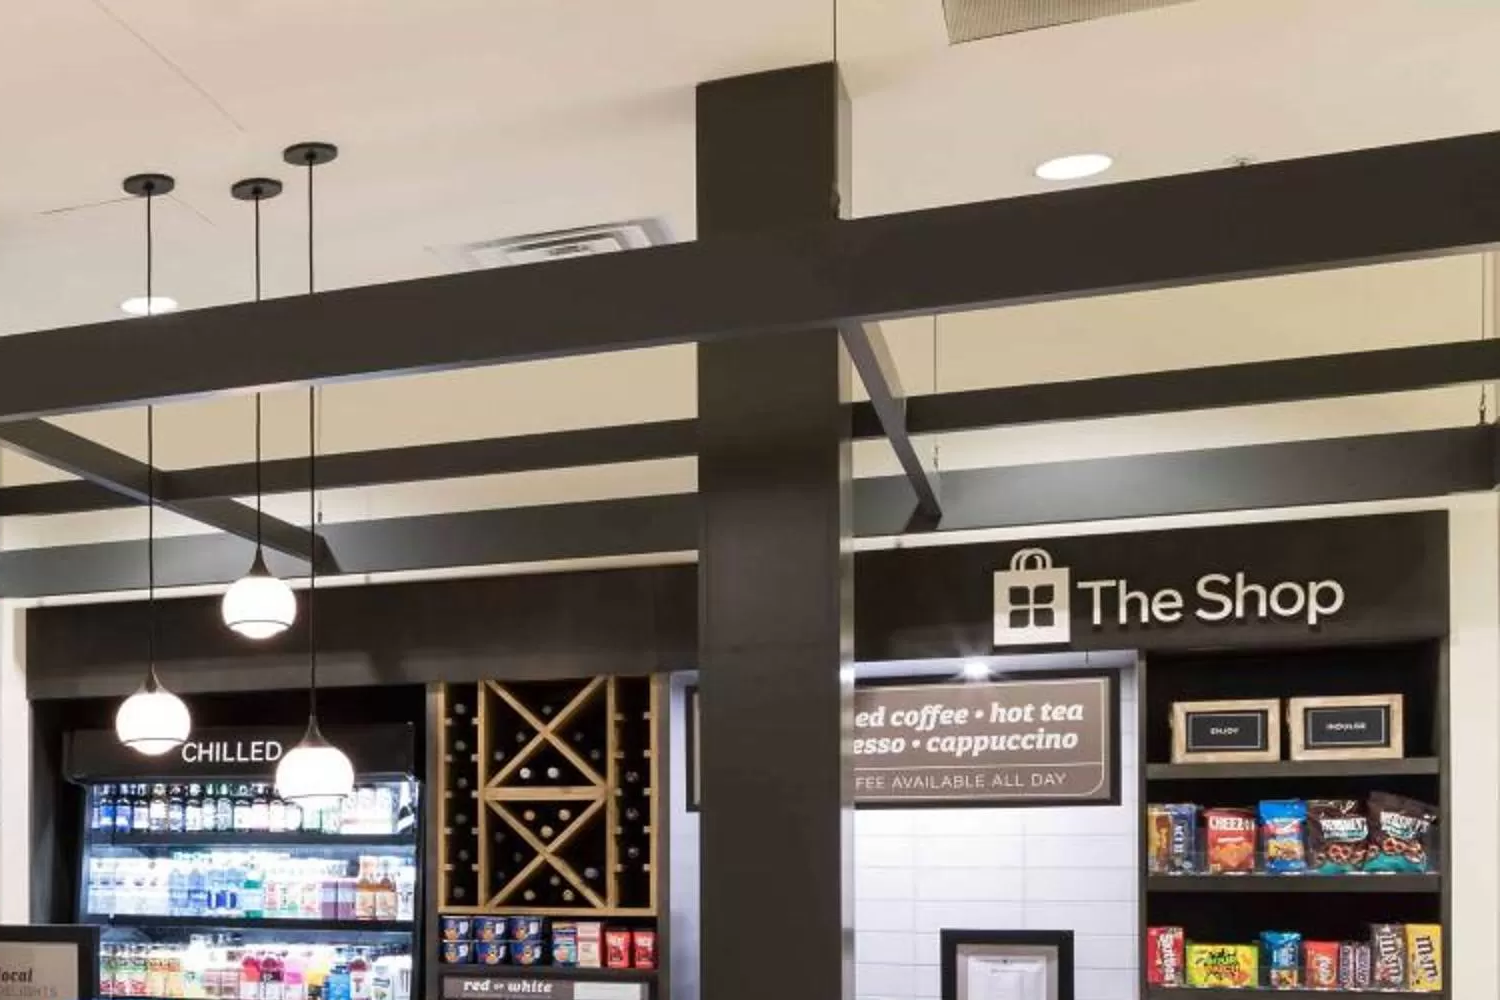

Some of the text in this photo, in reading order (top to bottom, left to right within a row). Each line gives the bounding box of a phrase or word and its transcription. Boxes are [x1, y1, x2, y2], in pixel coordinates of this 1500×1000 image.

[1077, 572, 1345, 625] The Shop
[890, 704, 969, 731] coffee
[990, 702, 1035, 723] hot
[1041, 704, 1084, 722] tea
[181, 741, 283, 763] CHILLED
[927, 728, 1079, 756] cappuccino
[891, 773, 985, 789] AVAILABLE
[991, 773, 1025, 788] ALL
[1031, 772, 1067, 786] DAY
[464, 979, 489, 992] red
[508, 979, 553, 993] white
